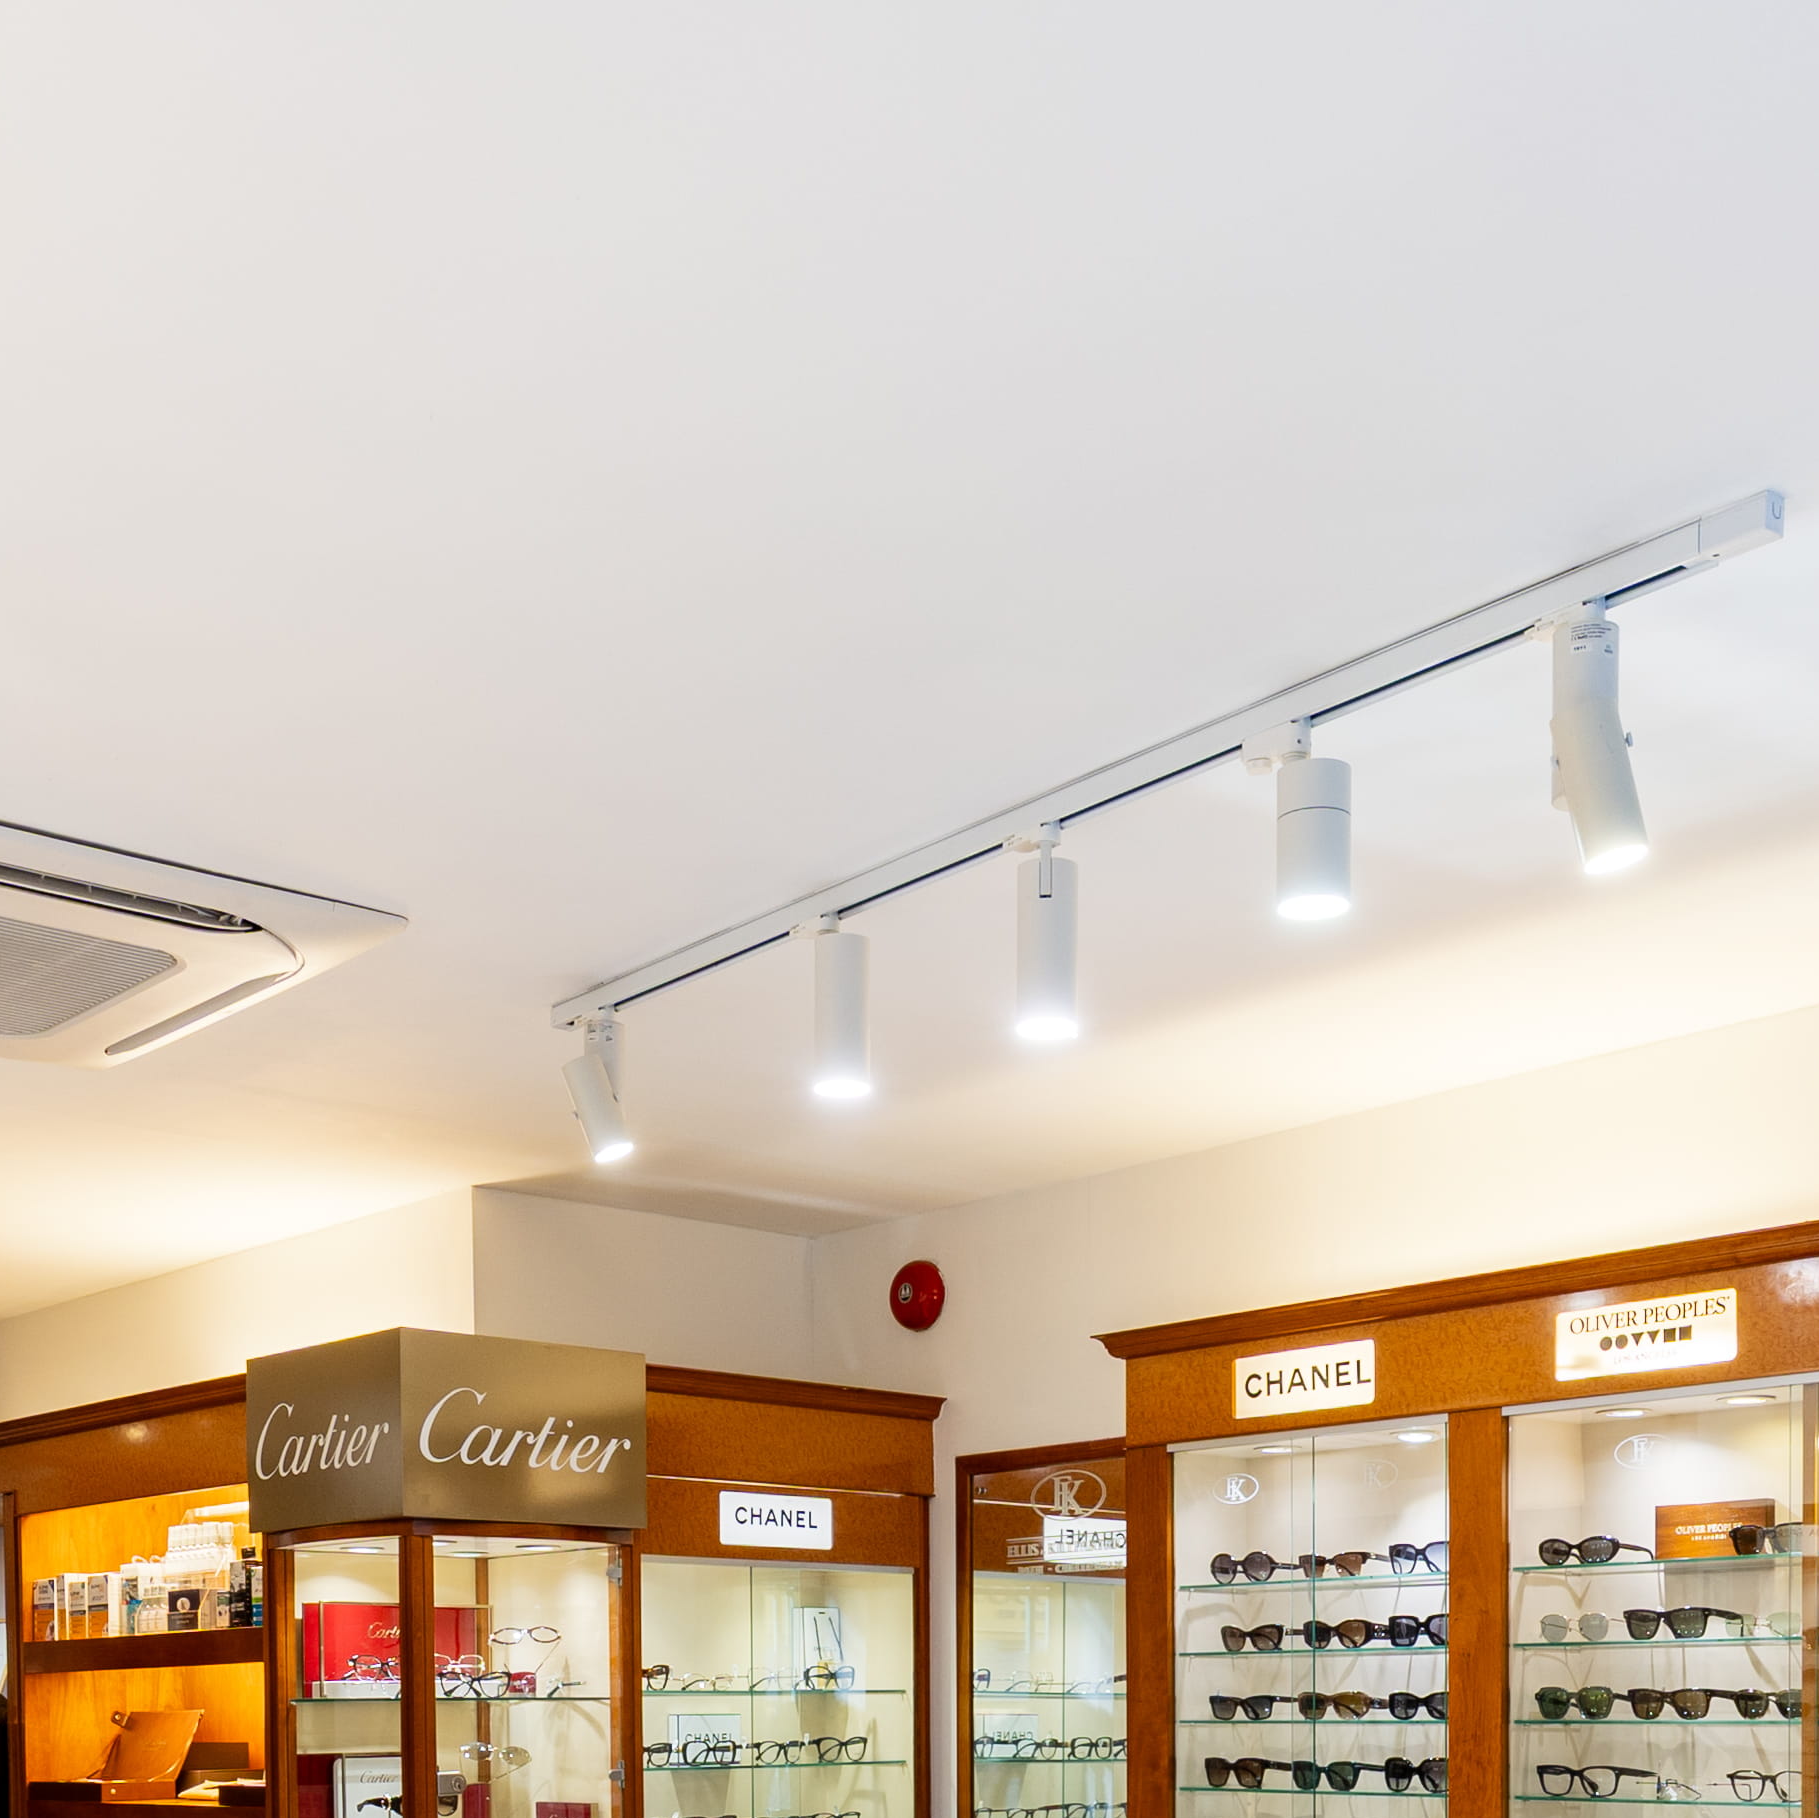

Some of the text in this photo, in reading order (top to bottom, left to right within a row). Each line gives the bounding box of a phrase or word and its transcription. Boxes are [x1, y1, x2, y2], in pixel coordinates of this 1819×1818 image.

[1570, 1296, 1728, 1335] OLIVER PEOPLES
[1244, 1359, 1372, 1399] CHANEL
[254, 1402, 390, 1481] Cartier
[418, 1386, 632, 1474] Cartier
[735, 1506, 819, 1530] CHANEL
[1675, 1524, 1706, 1535] OLIVER
